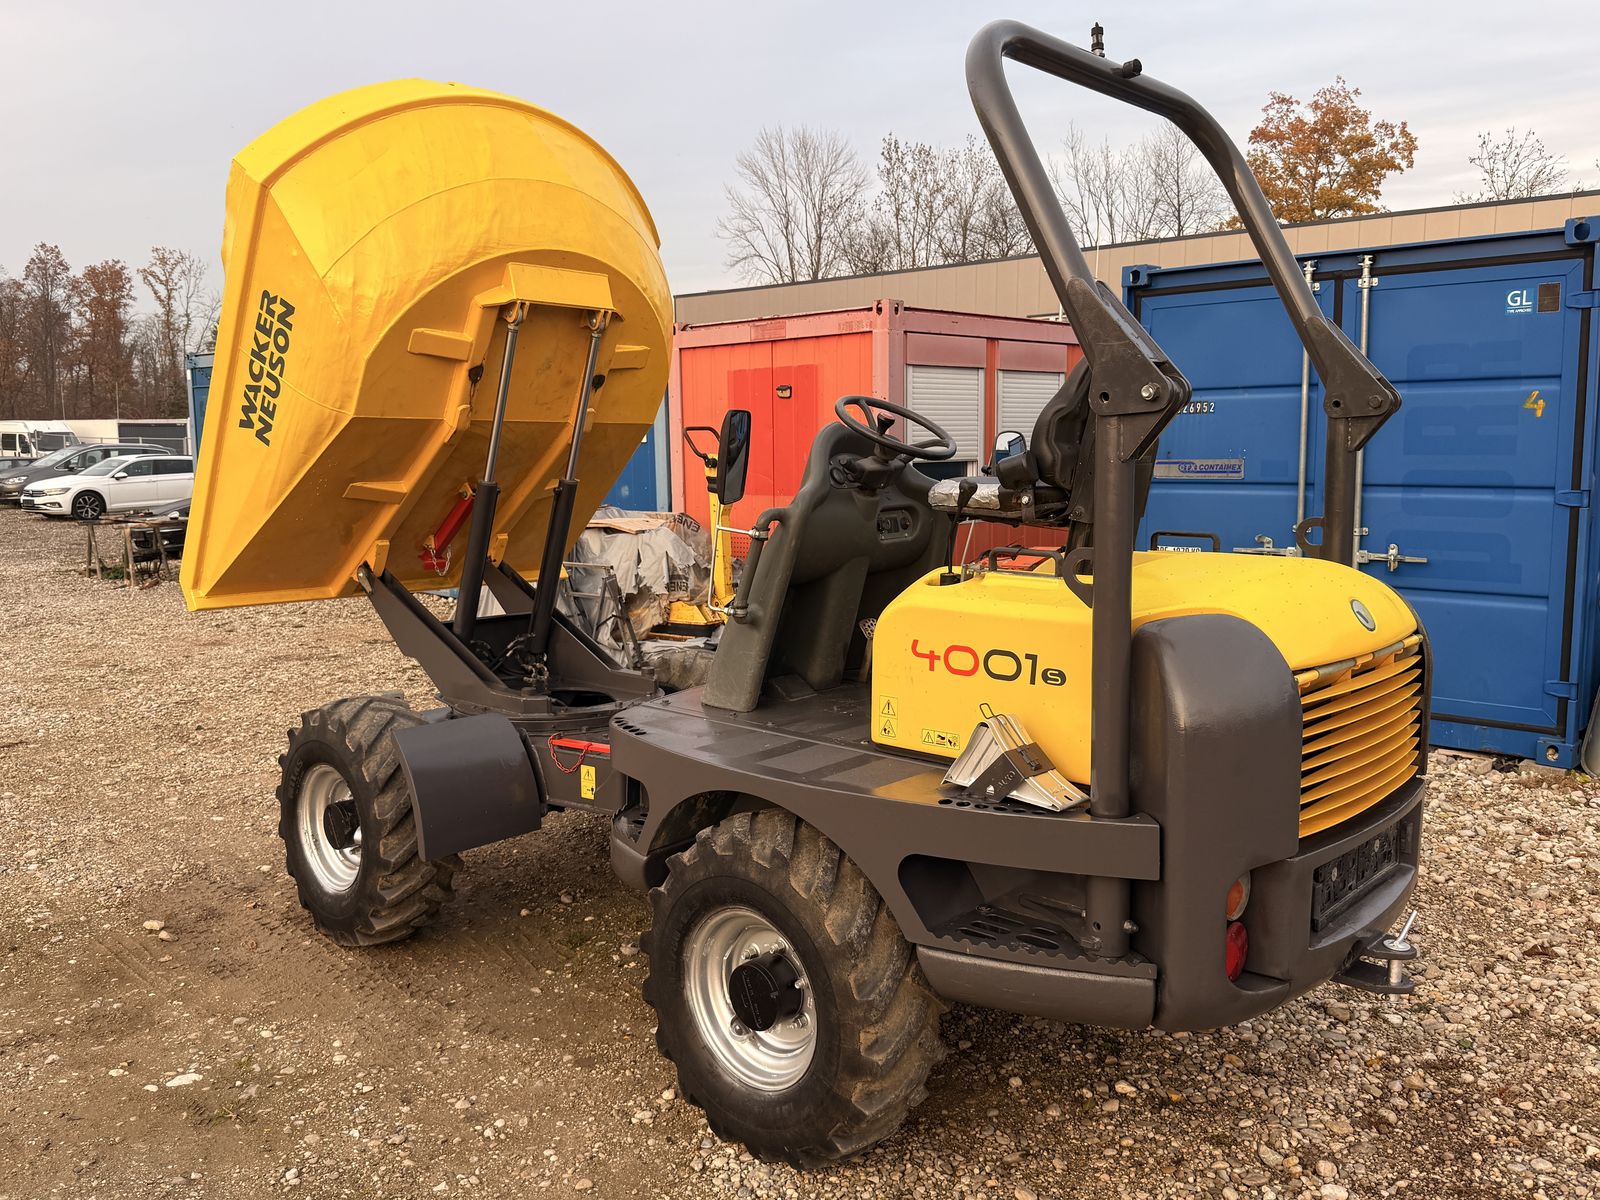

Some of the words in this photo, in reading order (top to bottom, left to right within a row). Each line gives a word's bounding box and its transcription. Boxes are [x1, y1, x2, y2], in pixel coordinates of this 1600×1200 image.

[1507, 289, 1533, 307] GL
[238, 289, 278, 430] WACKER
[255, 297, 296, 447] NEUSON
[1177, 402, 1215, 413] 26952
[1522, 389, 1546, 418] 4
[1199, 463, 1243, 471] CONTAINEX
